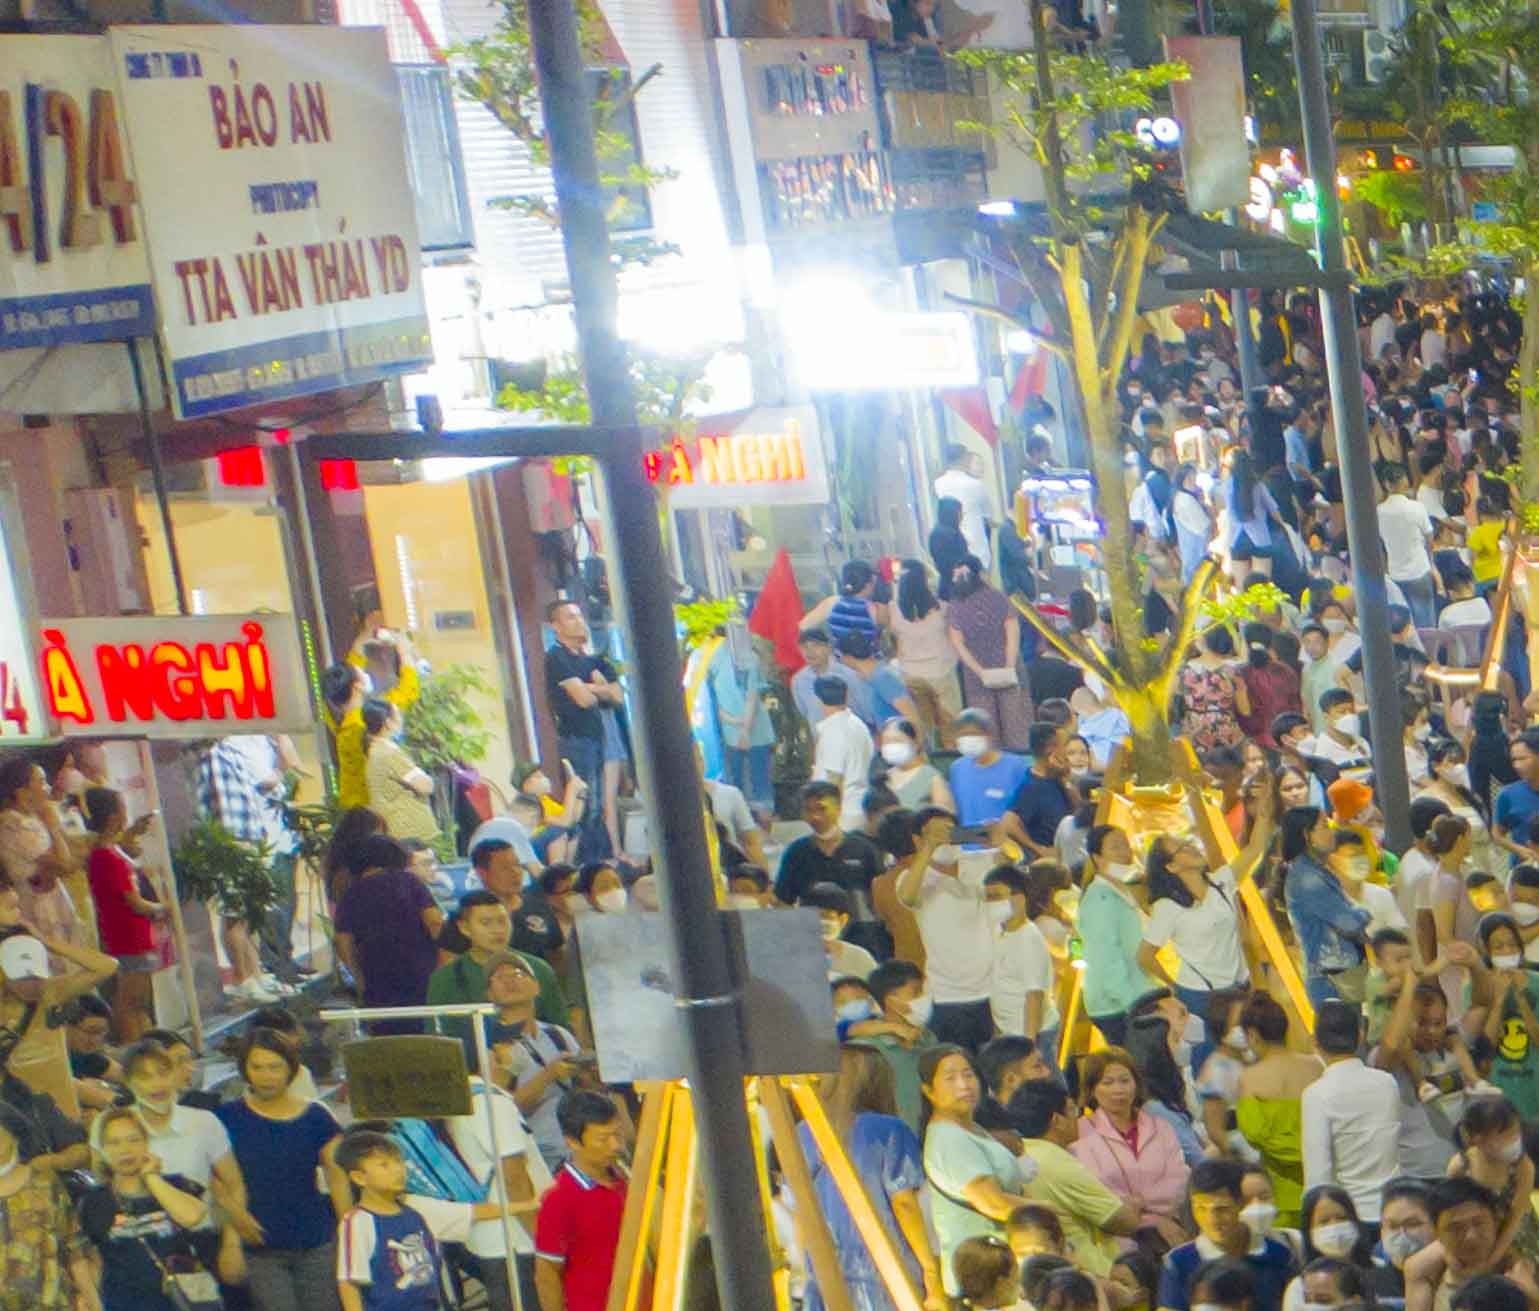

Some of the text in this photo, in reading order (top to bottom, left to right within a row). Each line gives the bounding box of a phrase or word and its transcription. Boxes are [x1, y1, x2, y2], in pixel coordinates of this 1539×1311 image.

[208, 57, 332, 150] BẢO AN
[236, 230, 304, 315] VÂN
[304, 216, 370, 306] THÁI
[95, 621, 276, 722] NGHỈ
